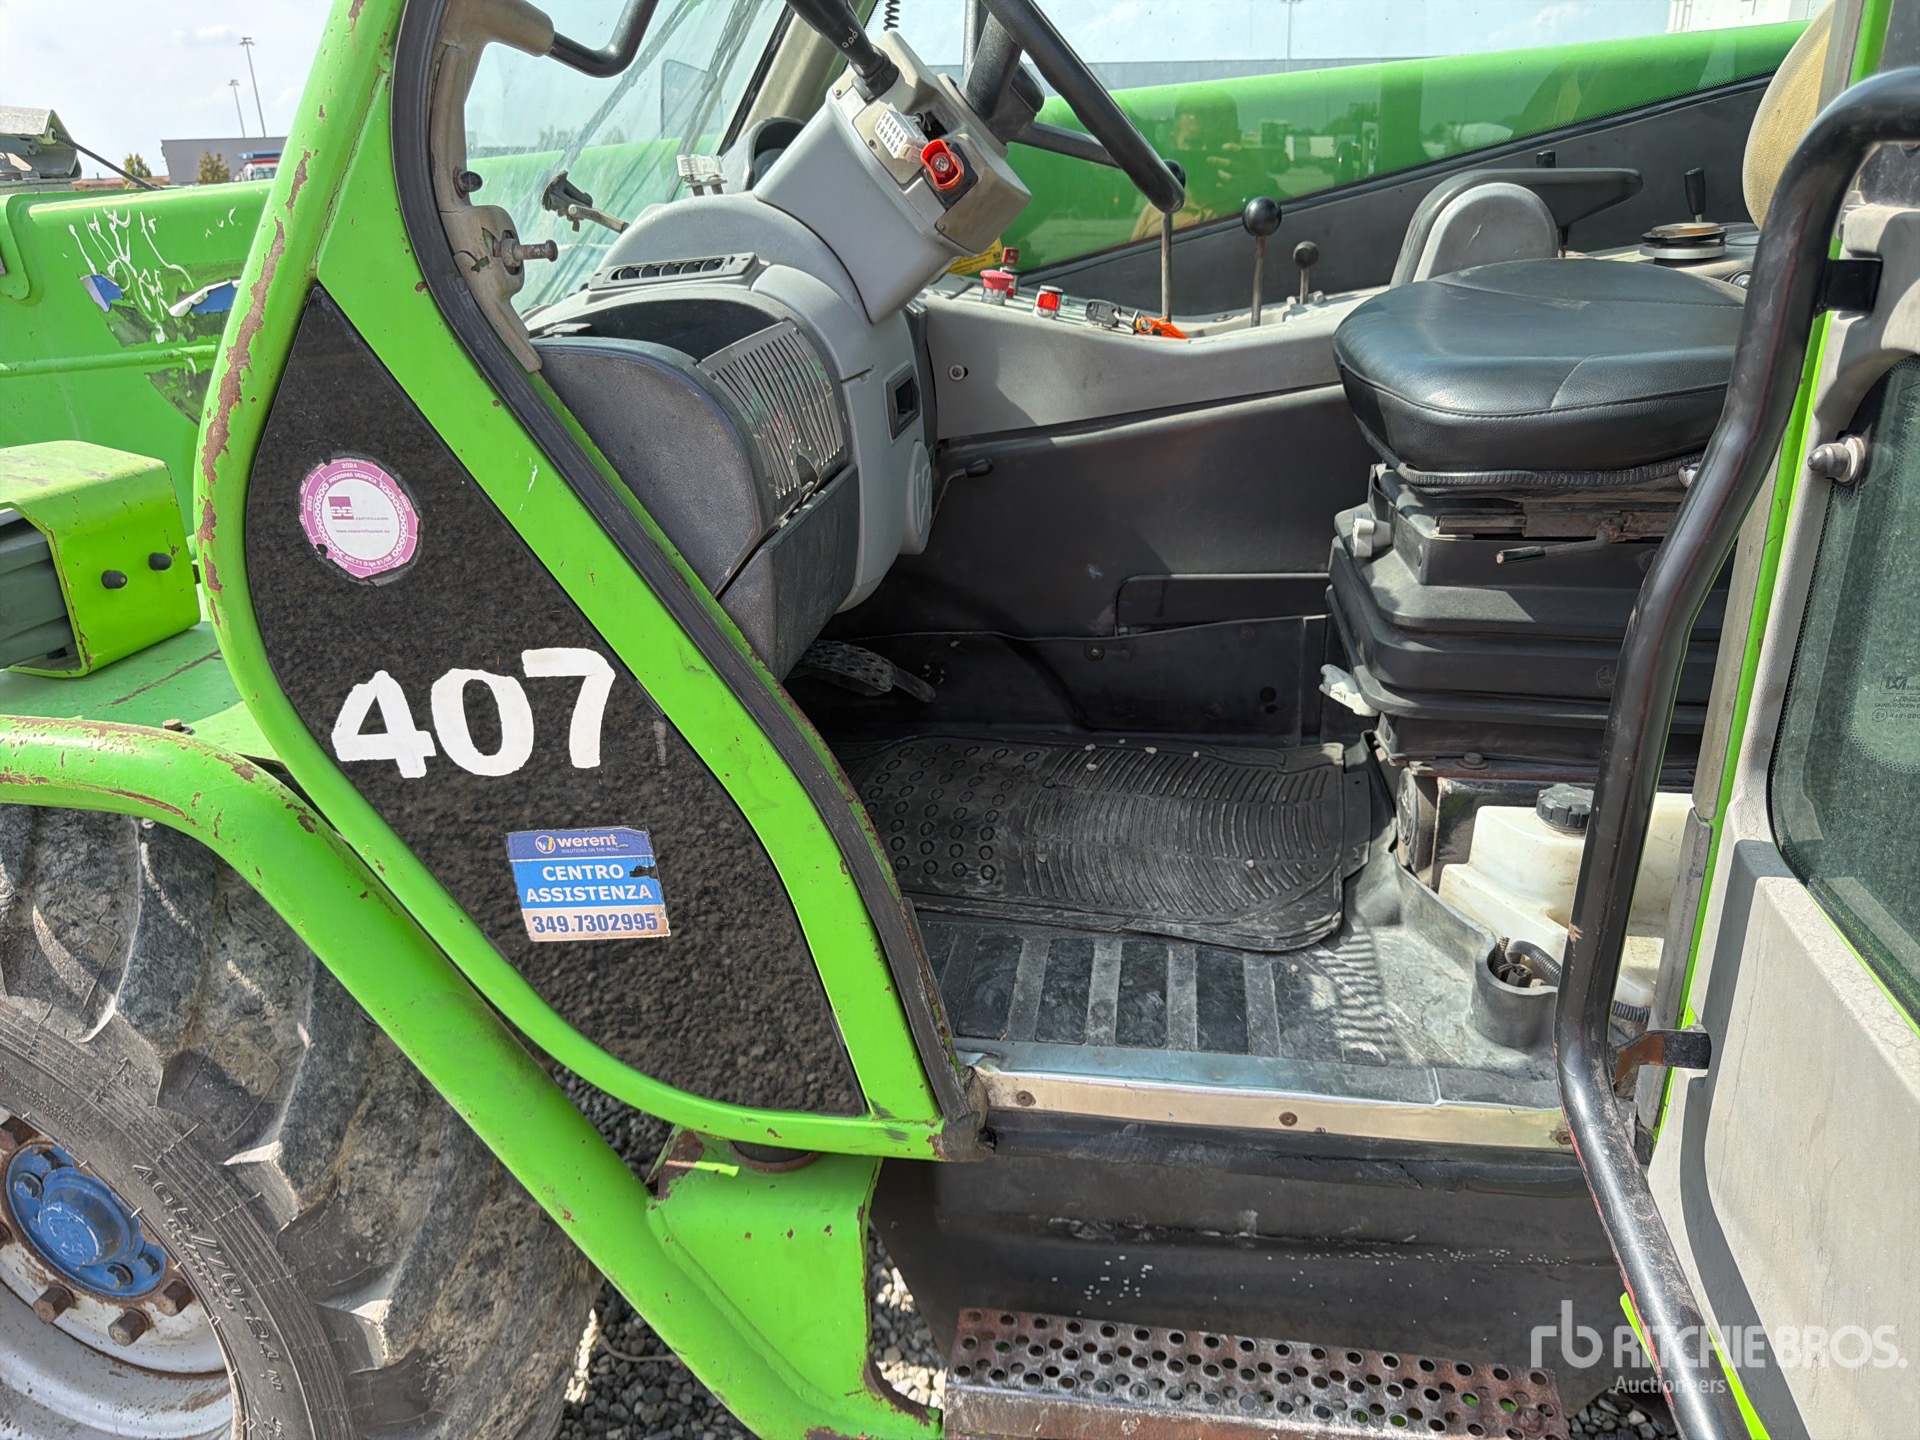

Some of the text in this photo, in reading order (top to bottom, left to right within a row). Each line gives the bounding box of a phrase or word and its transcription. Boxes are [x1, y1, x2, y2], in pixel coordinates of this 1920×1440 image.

[328, 472, 377, 484] PROSSIMA VERIFICA
[399, 495, 410, 512] 2020
[331, 647, 616, 779] 407
[556, 833, 617, 846] werent
[542, 864, 625, 882] CENTRO
[526, 885, 653, 903] ASSISTENZA
[532, 912, 658, 933] 349.7302995
[132, 1163, 280, 1363] 405/70-24
